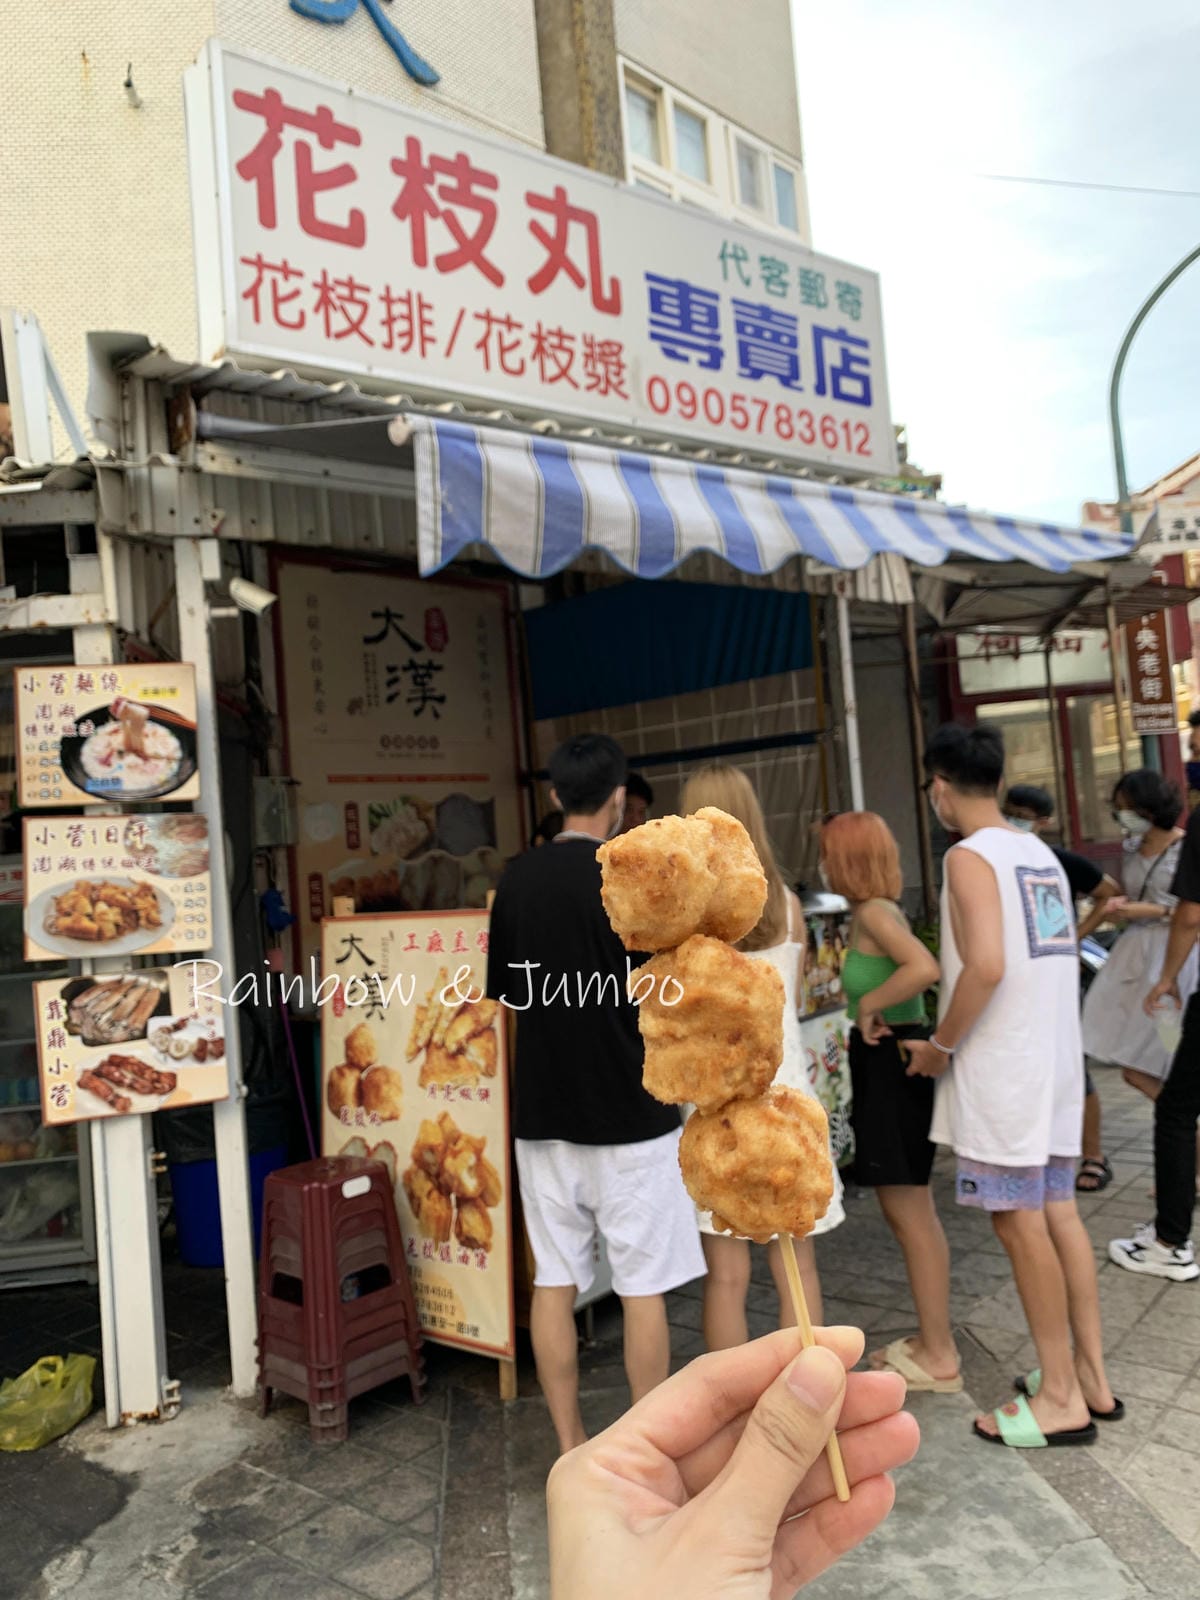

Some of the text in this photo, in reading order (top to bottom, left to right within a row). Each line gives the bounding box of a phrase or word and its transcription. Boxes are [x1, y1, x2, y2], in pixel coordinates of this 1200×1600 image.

[233, 88, 622, 316] 花枝丸
[719, 240, 863, 322] 代客郵寄
[645, 272, 872, 408] 專賣店
[646, 376, 872, 457] 0905783612
[363, 606, 447, 720] 大漢
[1134, 614, 1164, 701] 央老街
